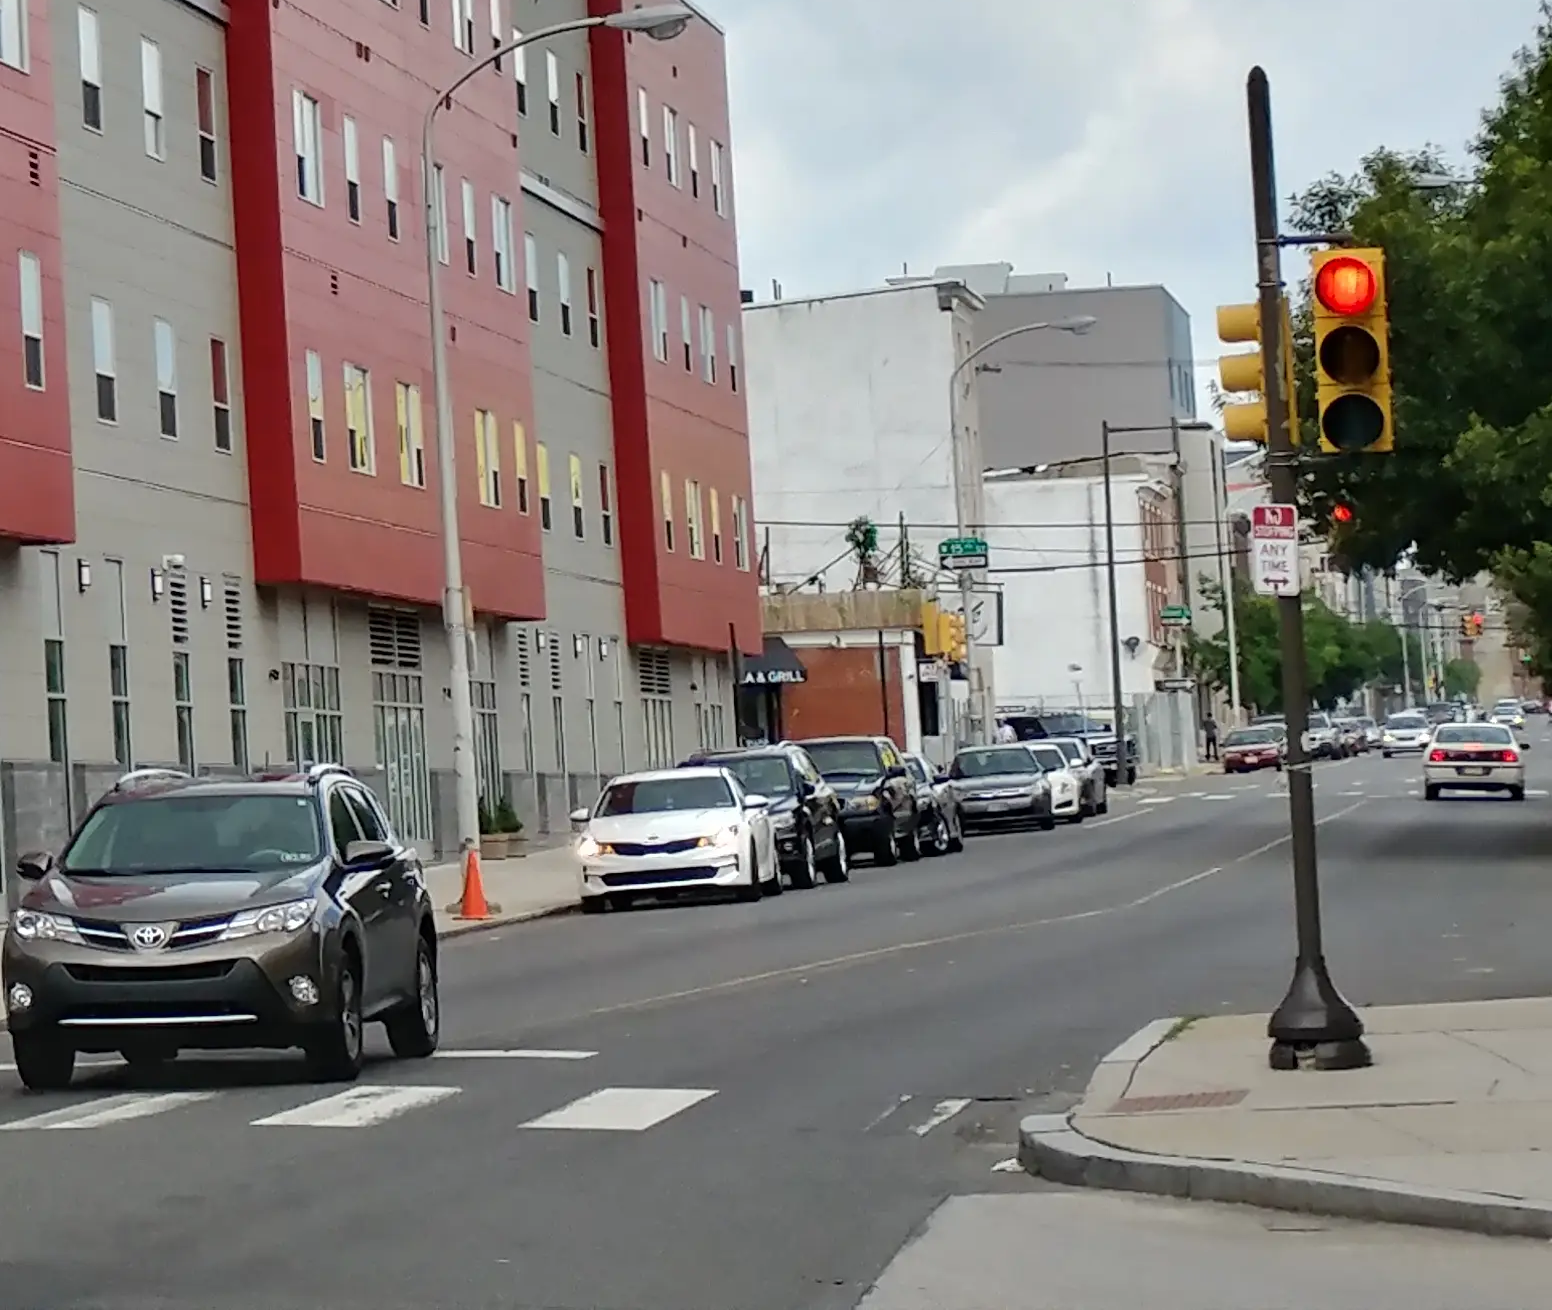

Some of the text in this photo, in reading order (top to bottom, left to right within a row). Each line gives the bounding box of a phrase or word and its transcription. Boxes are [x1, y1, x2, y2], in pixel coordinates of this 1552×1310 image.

[1264, 508, 1283, 525] NO
[1260, 543, 1288, 556] ANY
[1262, 560, 1290, 573] TIME
[767, 670, 805, 683] GRILL
